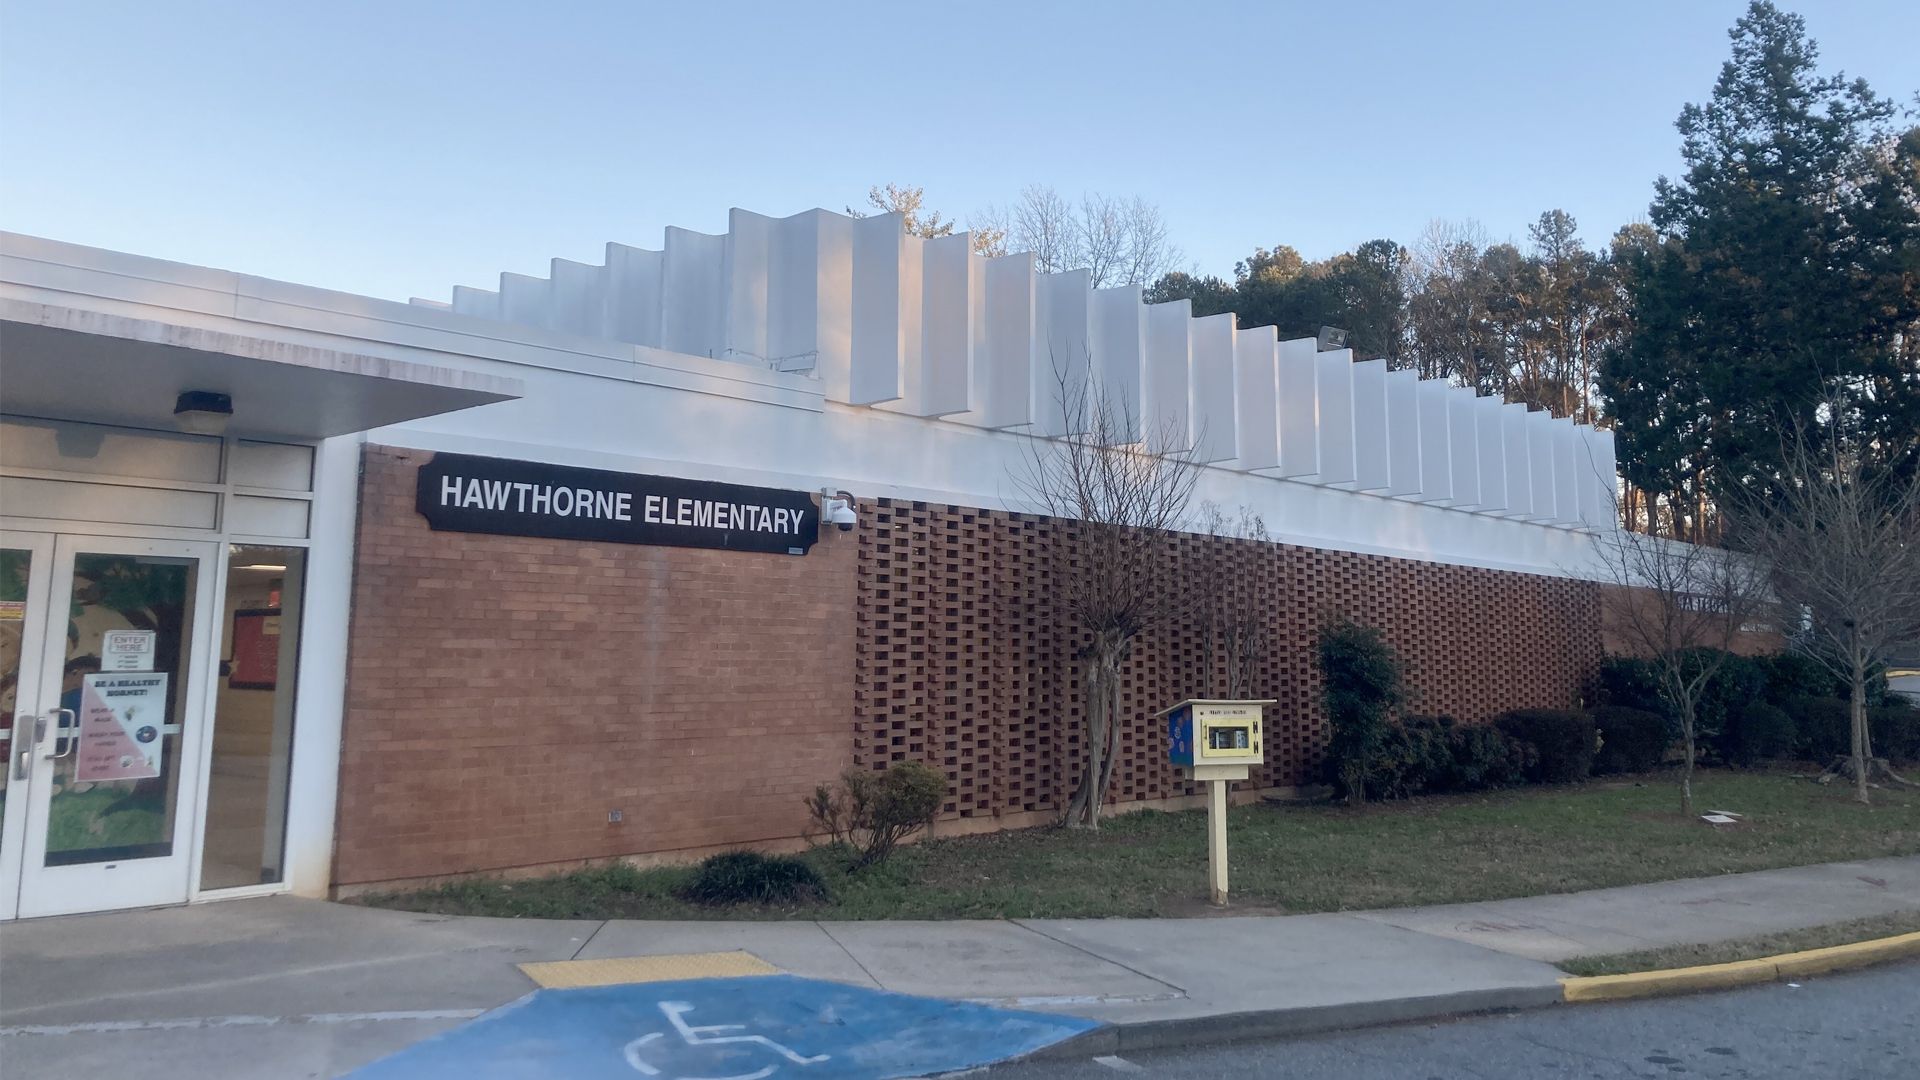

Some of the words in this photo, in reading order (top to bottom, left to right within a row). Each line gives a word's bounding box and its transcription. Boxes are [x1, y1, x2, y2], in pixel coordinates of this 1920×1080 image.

[440, 475, 632, 521] HAWTHORNE
[644, 495, 804, 535] ELEMENTARY
[113, 636, 146, 644] ENTER
[116, 644, 142, 652] HERE
[108, 680, 116, 688] A
[117, 679, 161, 688] HEALTHY
